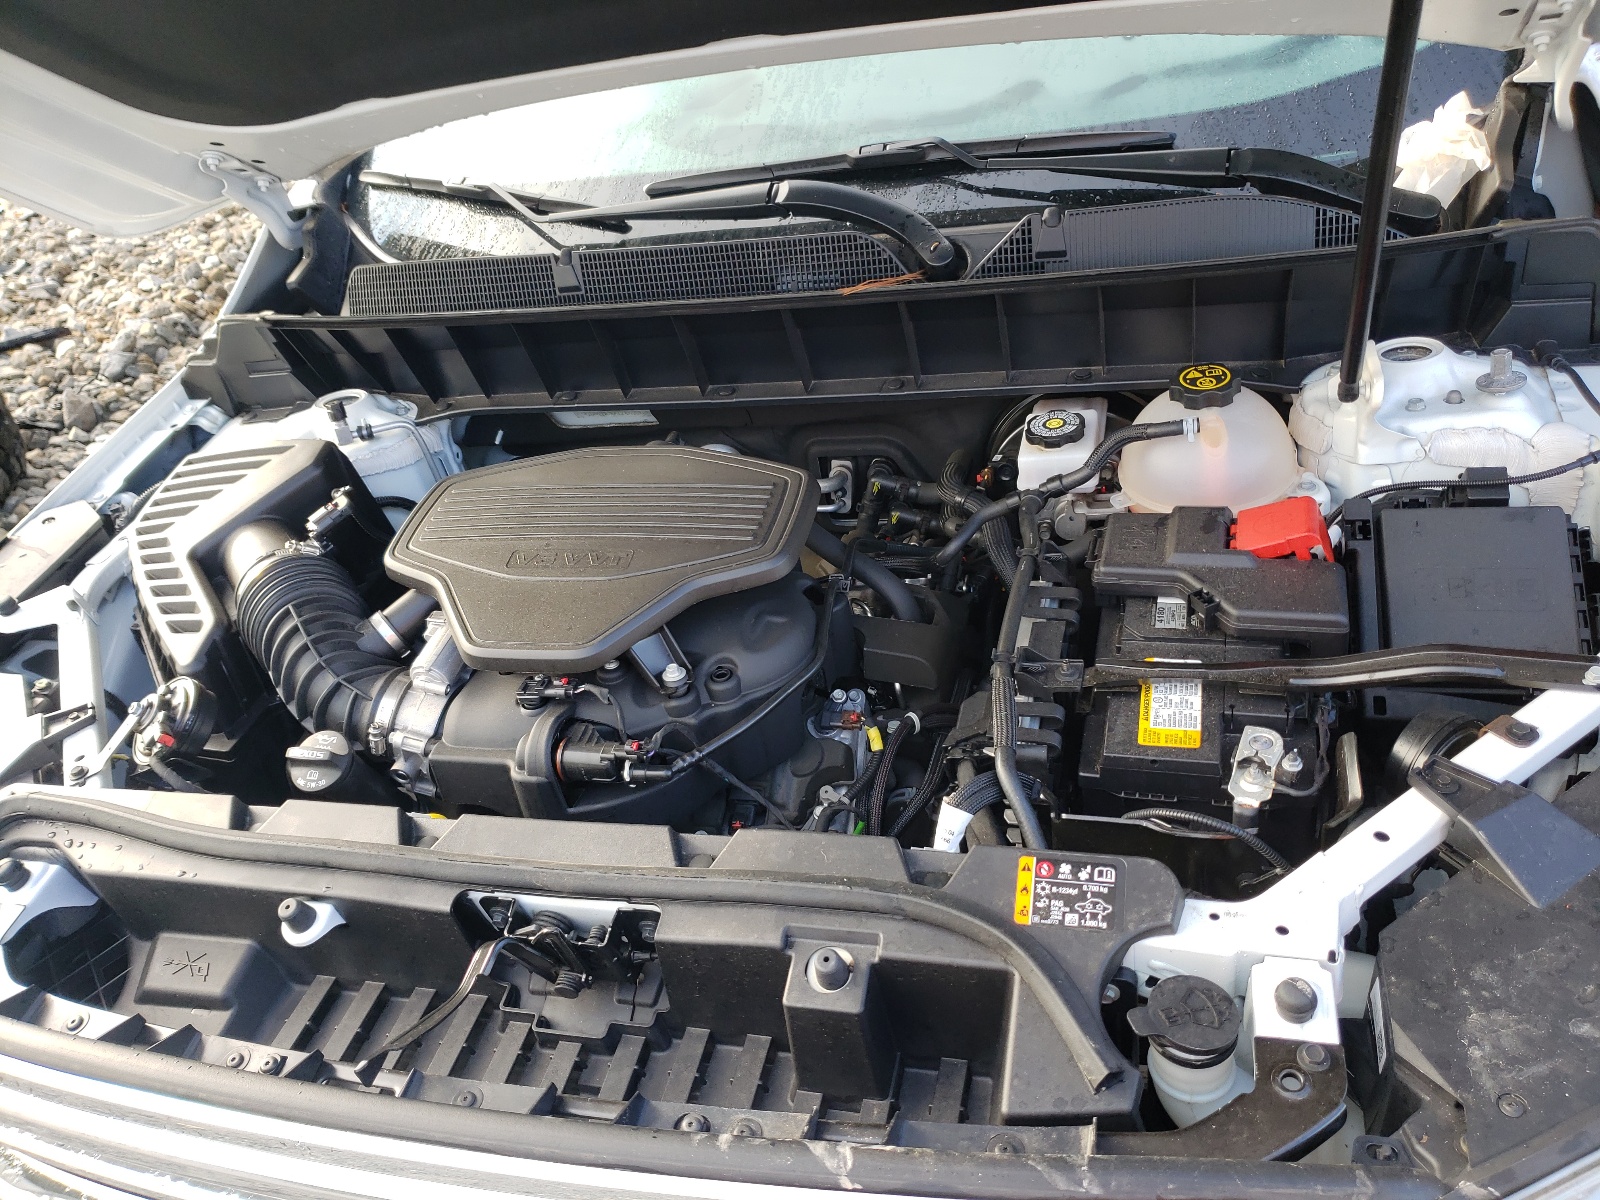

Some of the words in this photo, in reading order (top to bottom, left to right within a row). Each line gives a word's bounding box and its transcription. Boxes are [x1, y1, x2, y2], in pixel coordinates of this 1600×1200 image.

[1157, 606, 1166, 624] 4180
[1099, 885, 1109, 894] kg
[1098, 920, 1108, 929] kg
